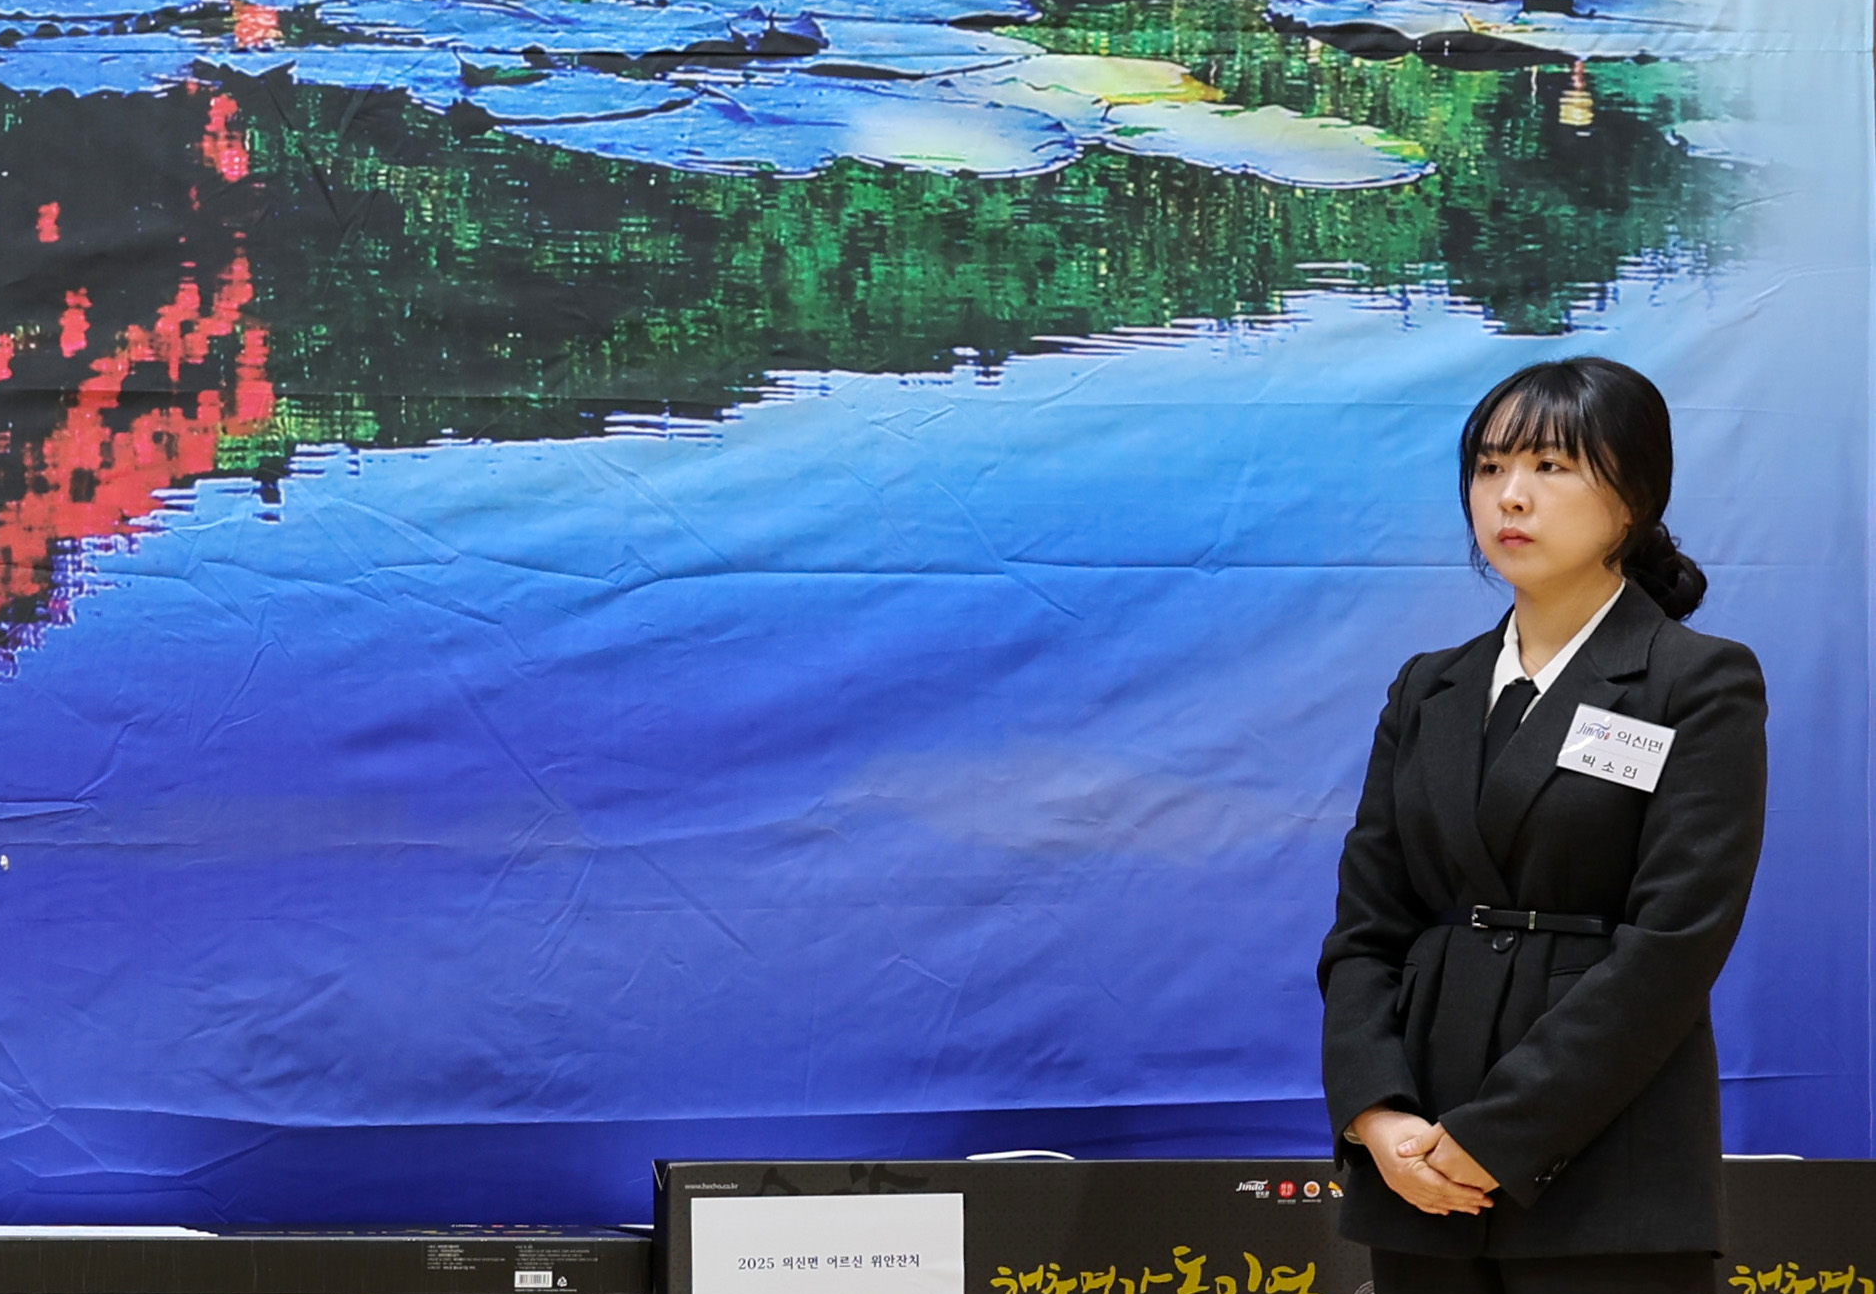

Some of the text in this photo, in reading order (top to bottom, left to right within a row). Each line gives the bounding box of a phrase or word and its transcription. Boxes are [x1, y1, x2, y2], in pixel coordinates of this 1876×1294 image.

[1615, 731, 1664, 754] 의신면
[737, 1253, 920, 1271] 2025 의신면 어르신 위안잔치
